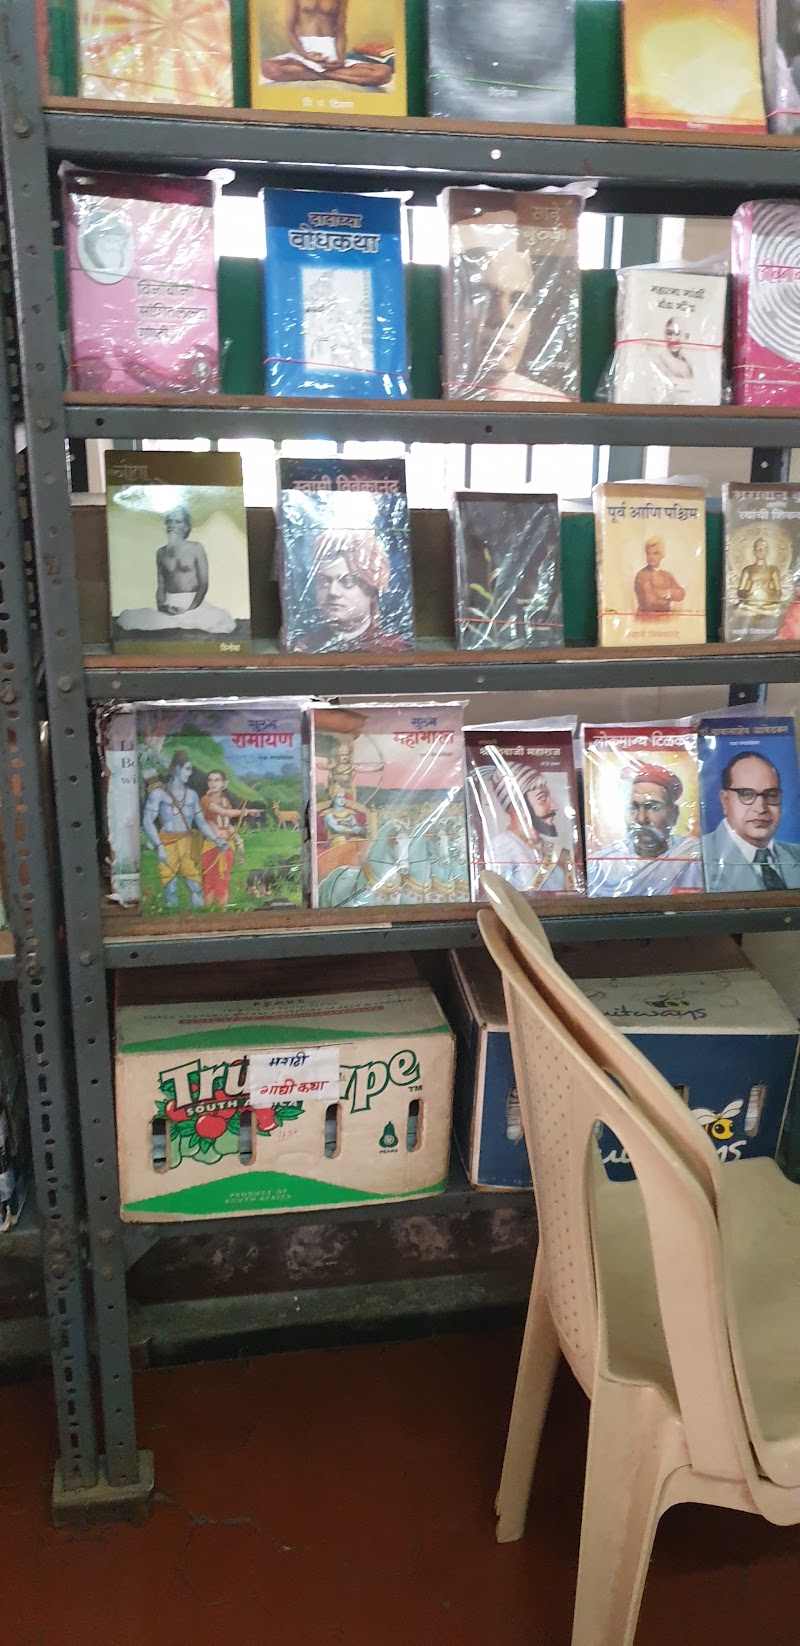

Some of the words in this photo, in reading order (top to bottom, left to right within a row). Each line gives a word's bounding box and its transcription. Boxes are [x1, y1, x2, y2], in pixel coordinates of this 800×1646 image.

[287, 223, 381, 253] बोधकथा
[336, 474, 399, 493] विवेकानंद
[607, 501, 626, 523] पूर्व
[630, 502, 662, 519] आणि
[664, 502, 698, 521] पश्चिम
[231, 732, 294, 749] रामायण
[393, 730, 454, 748] महाभारत
[269, 1051, 310, 1067] मराठी
[298, 1080, 329, 1094] कथा
[186, 1099, 239, 1117] SOUTH
